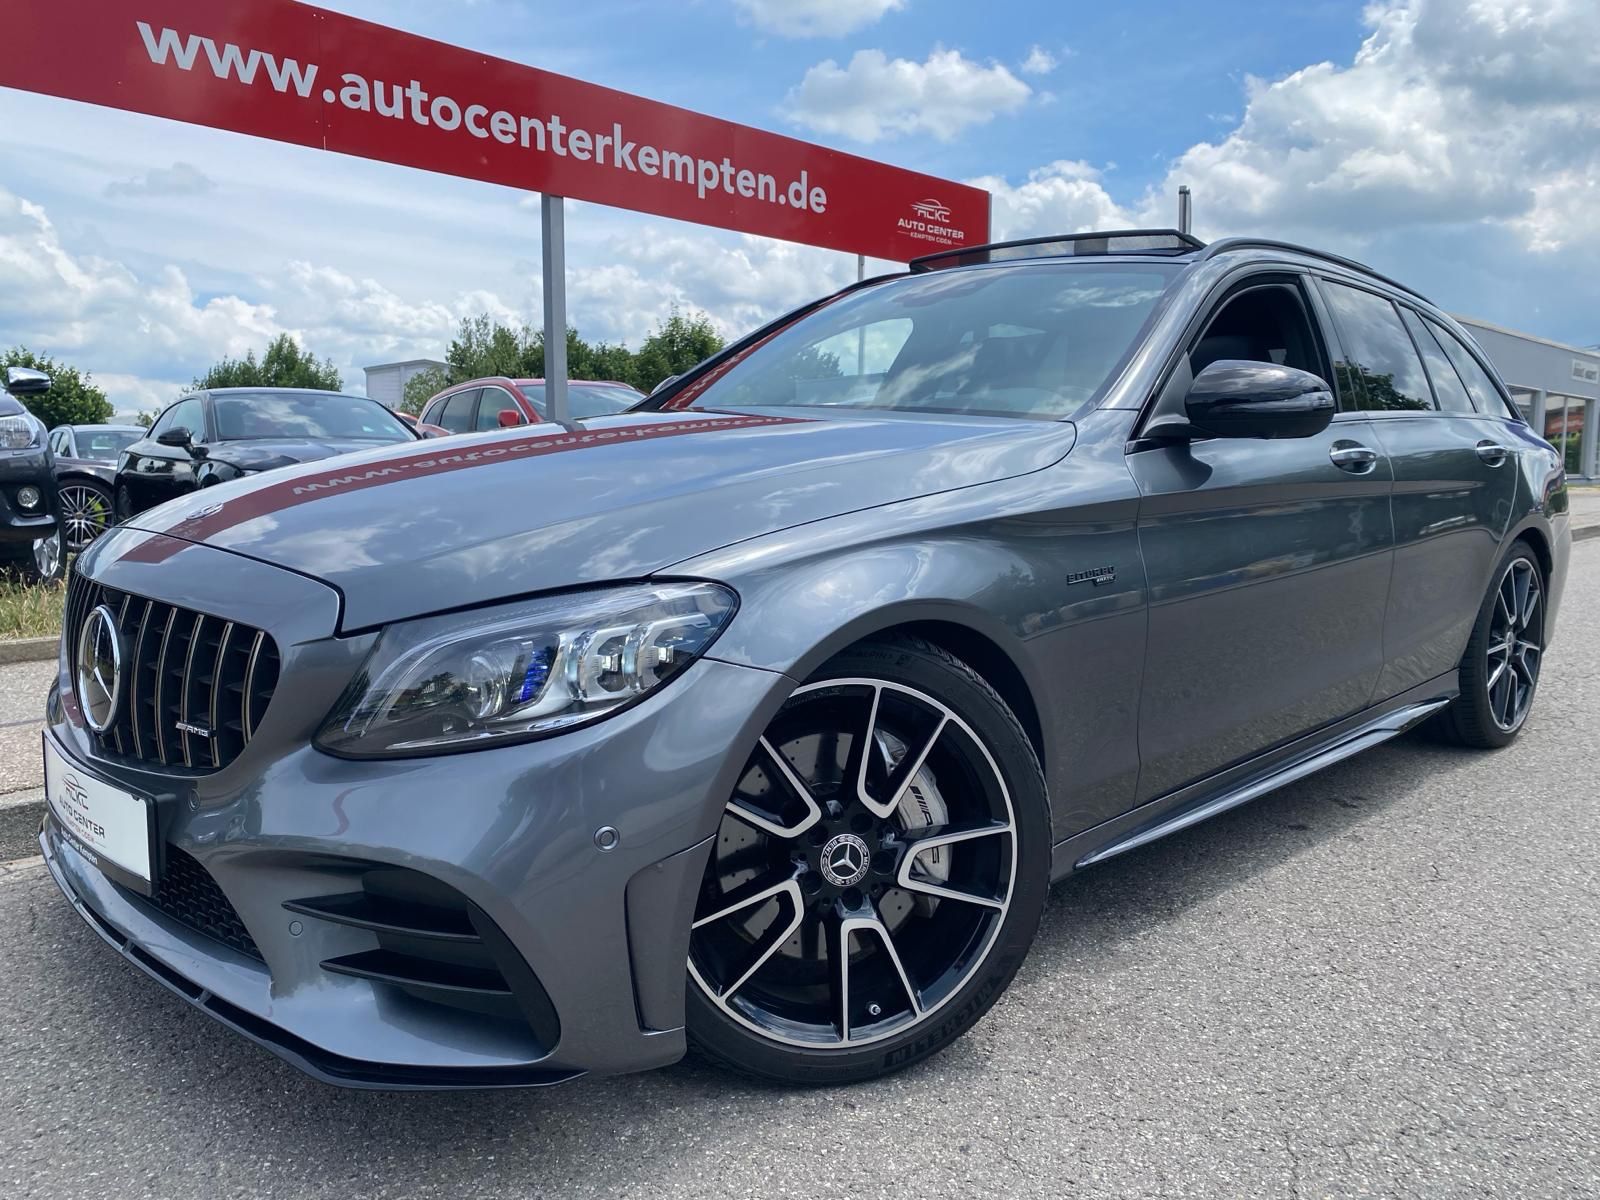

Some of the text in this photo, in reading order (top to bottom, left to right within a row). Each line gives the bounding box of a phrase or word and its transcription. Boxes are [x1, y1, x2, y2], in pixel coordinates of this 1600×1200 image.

[136, 21, 827, 213] www.autocenterkempten.de
[898, 218, 964, 239] AUTO CENTER
[910, 232, 935, 242] KEMPTEN
[185, 725, 208, 737] AMG
[73, 809, 105, 838] CENTER
